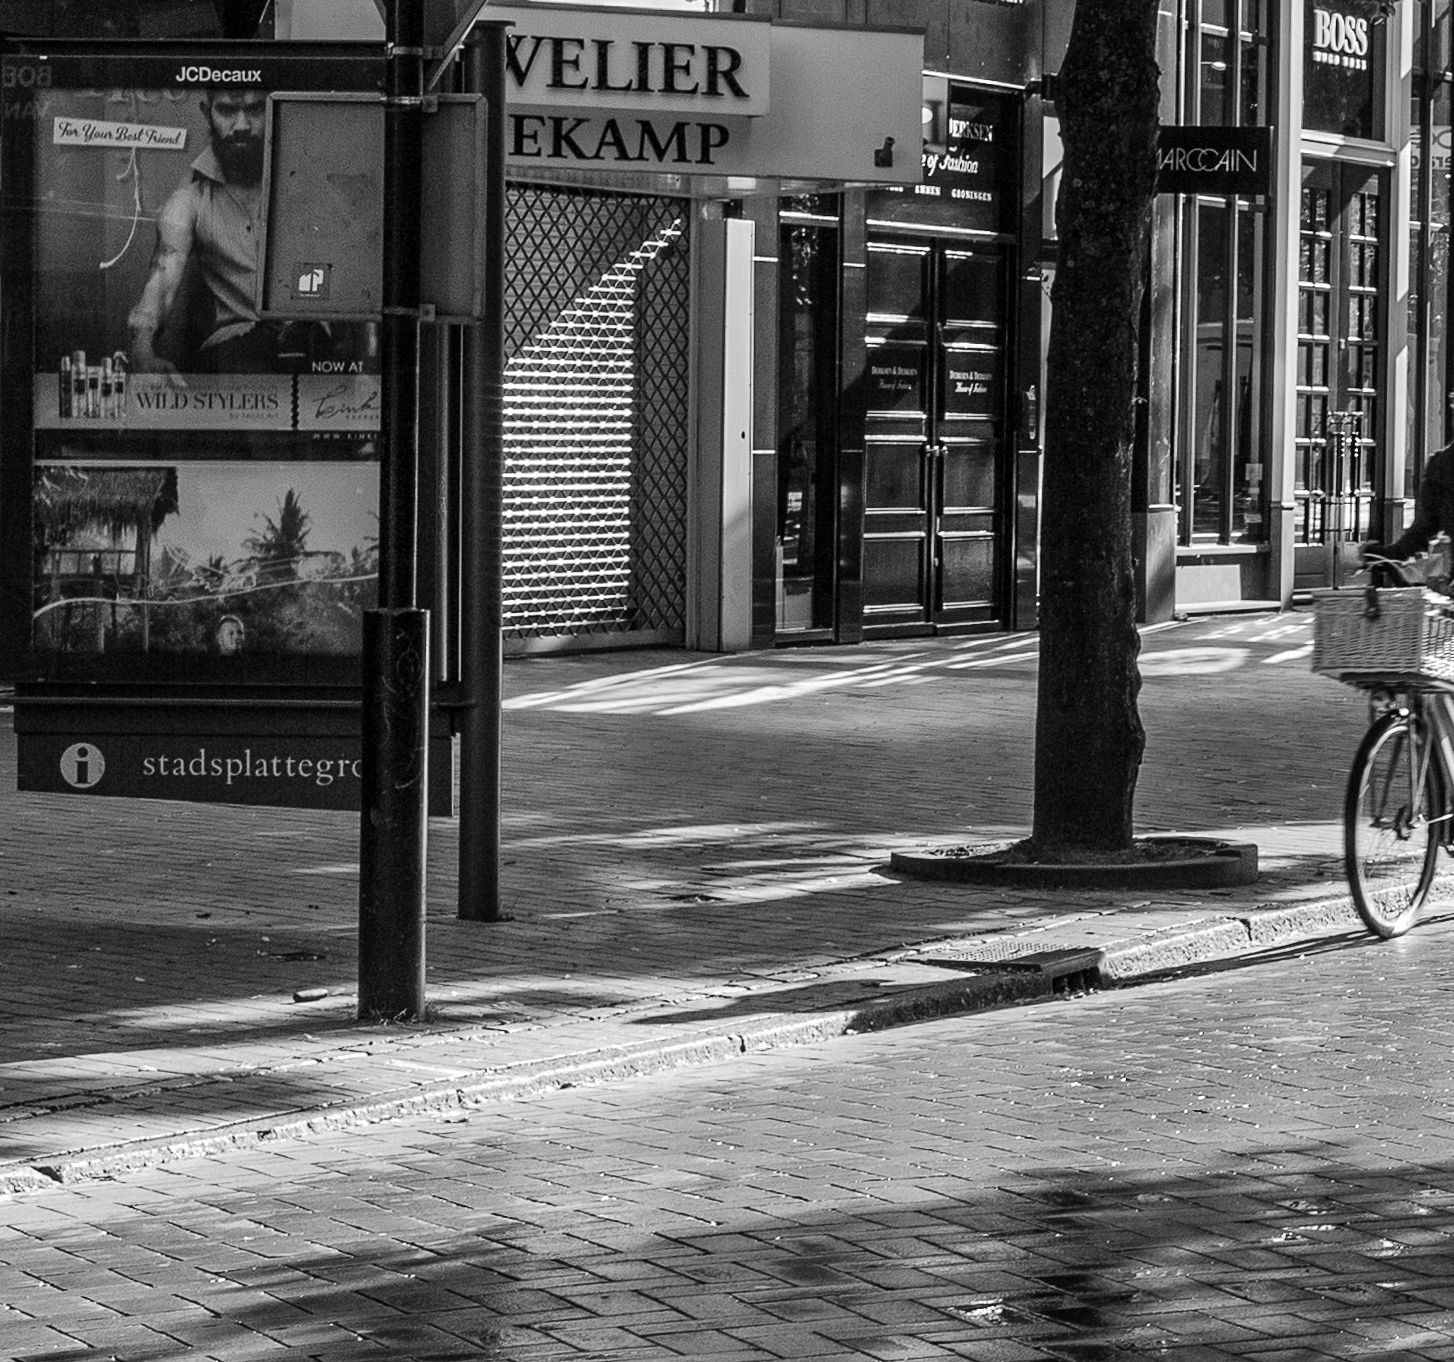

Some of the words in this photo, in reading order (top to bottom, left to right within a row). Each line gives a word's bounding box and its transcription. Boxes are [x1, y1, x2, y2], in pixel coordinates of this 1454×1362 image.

[1313, 9, 1368, 56] BOSS
[175, 66, 261, 82] JCDecaux
[506, 34, 750, 98] WELIER
[58, 121, 80, 137] For
[81, 124, 113, 142] Your
[115, 126, 143, 142] Best
[146, 128, 181, 146] Friend
[508, 113, 730, 165] EKAMP
[311, 361, 346, 373] NOW
[348, 361, 364, 373] AT
[137, 393, 188, 410] WILD
[193, 393, 279, 410] STYLERS
[142, 748, 361, 786] stadsplattegro
